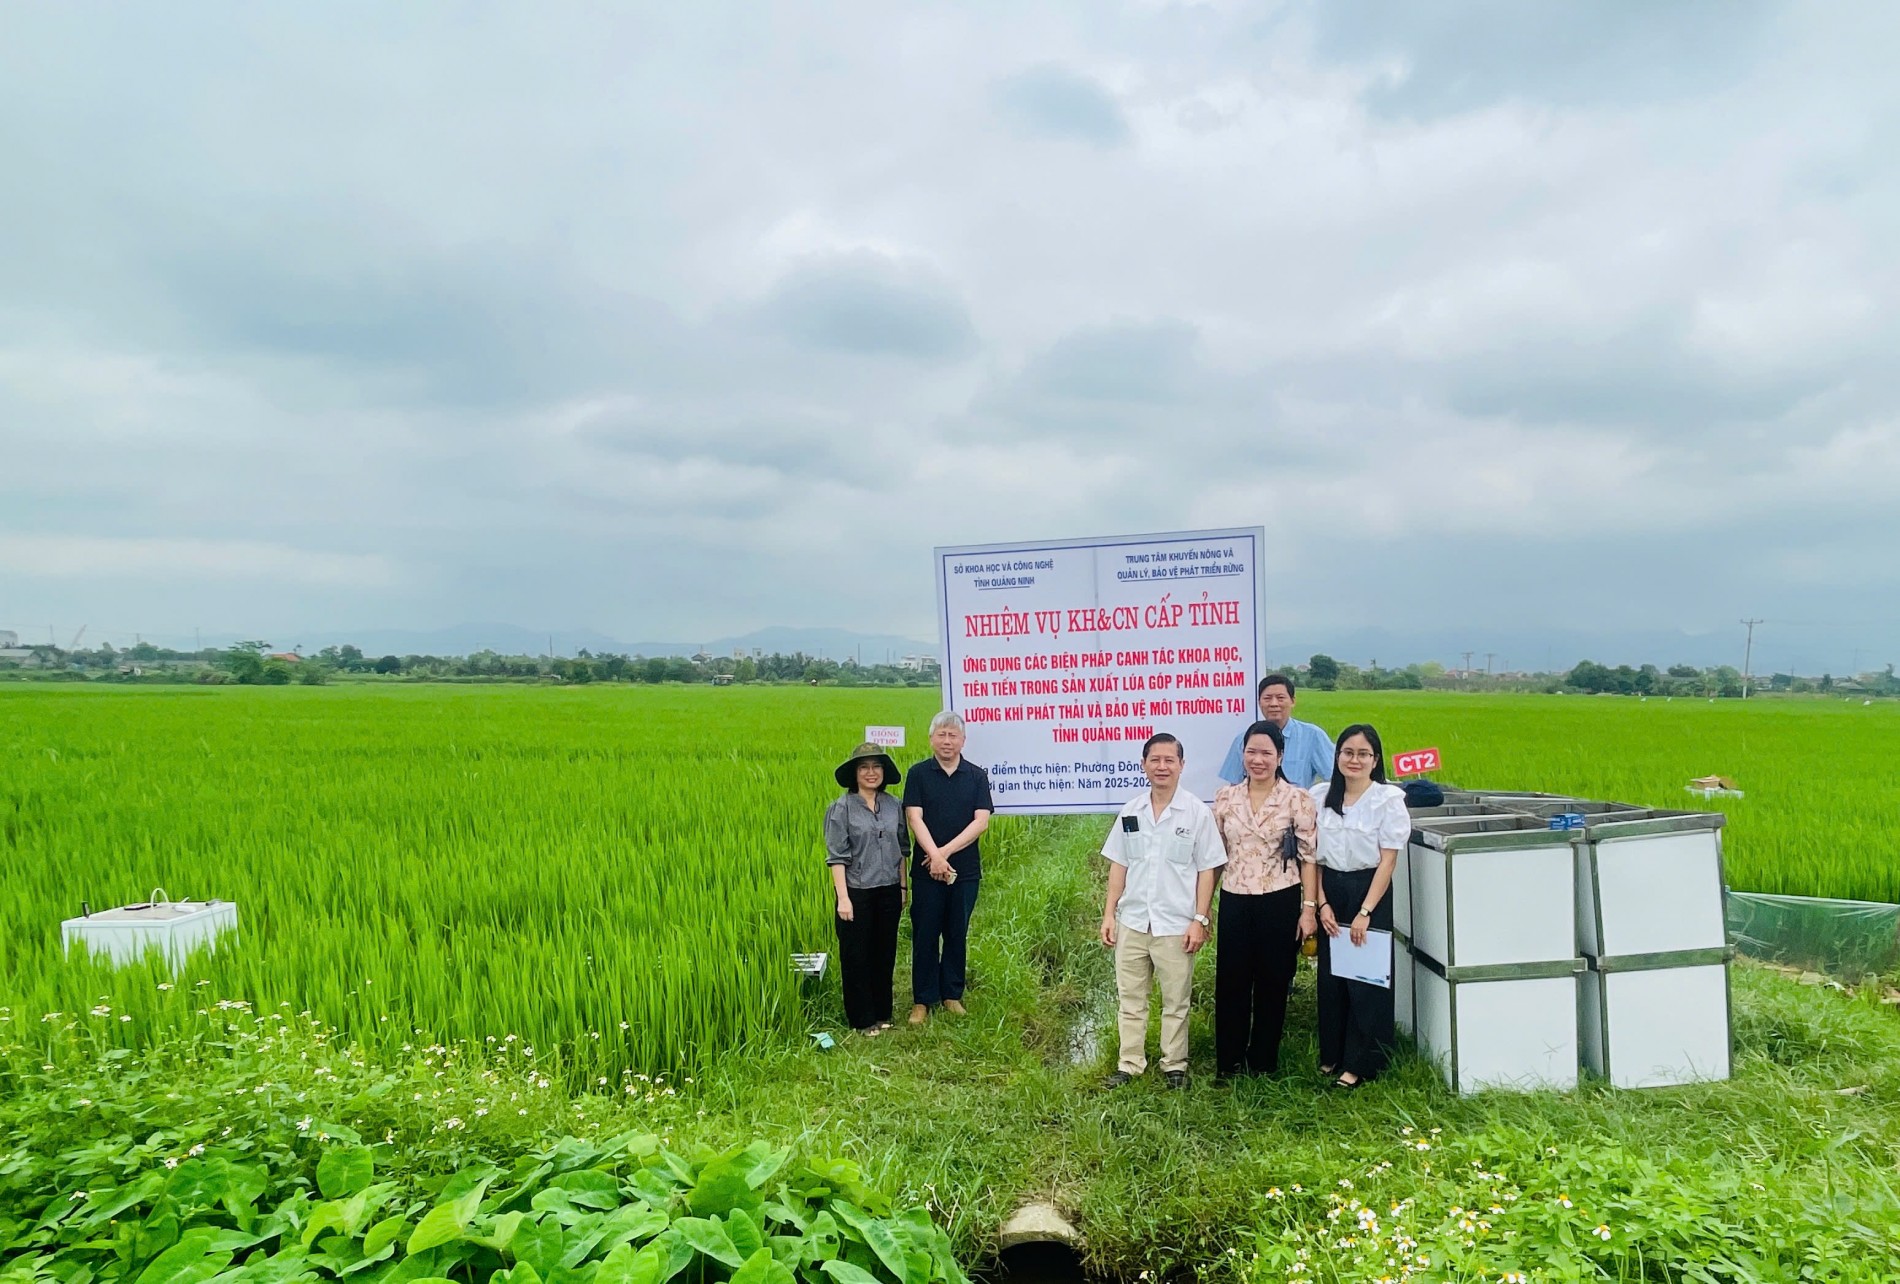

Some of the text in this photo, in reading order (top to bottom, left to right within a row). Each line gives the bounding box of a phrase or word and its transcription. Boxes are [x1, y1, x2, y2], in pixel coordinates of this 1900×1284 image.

[1126, 554, 1149, 564] TRUNG
[1151, 552, 1166, 562] TÂM
[1169, 548, 1198, 561] KHUYẾN
[1200, 548, 1221, 560] NÔNG
[965, 564, 984, 573] KHOA
[986, 564, 1000, 574] HỌC
[1014, 560, 1033, 571] CÔNG
[1035, 558, 1054, 570] NGHỆ
[1117, 567, 1137, 579] QUẢN
[1152, 566, 1167, 577] BẢO
[1169, 566, 1178, 578] VỆ
[1180, 565, 1199, 576] PHÁT
[1201, 561, 1221, 574] TRIỂN
[1223, 562, 1244, 573] RỪNG
[974, 575, 1034, 587] TỈNH QUẢNG NINH
[965, 591, 1240, 642] NHIỆM VỤ KH&CN CẤP TỈNH
[963, 647, 1242, 674] ỨNG DỤNG CÁC BIỆN PHÁP CANH TÁC KHOA HỌC,
[963, 666, 1244, 697] TIÊN TIẾN TRONG SẢN XUẤT LÚA GÓP PHẦN GIẢM
[965, 696, 1245, 726] LƯỢNG KHÍ PHÁT THẢI VÀ BẢO VỆ MÔI TRƯỜNG TẠI
[871, 728, 899, 737] GIỐNG
[1053, 721, 1153, 743] TỈNH QUẢNG NINH
[992, 761, 1017, 775] điểm
[1020, 764, 1042, 776] thực
[1045, 763, 1071, 776] hiện:
[1074, 761, 1115, 774] Phường
[1399, 753, 1435, 772] CT2
[999, 780, 1020, 793] gian
[1023, 780, 1046, 792] thực
[1049, 779, 1074, 792] hiện:
[1078, 779, 1101, 789] Năm
[1104, 777, 1151, 788] 2025-202
